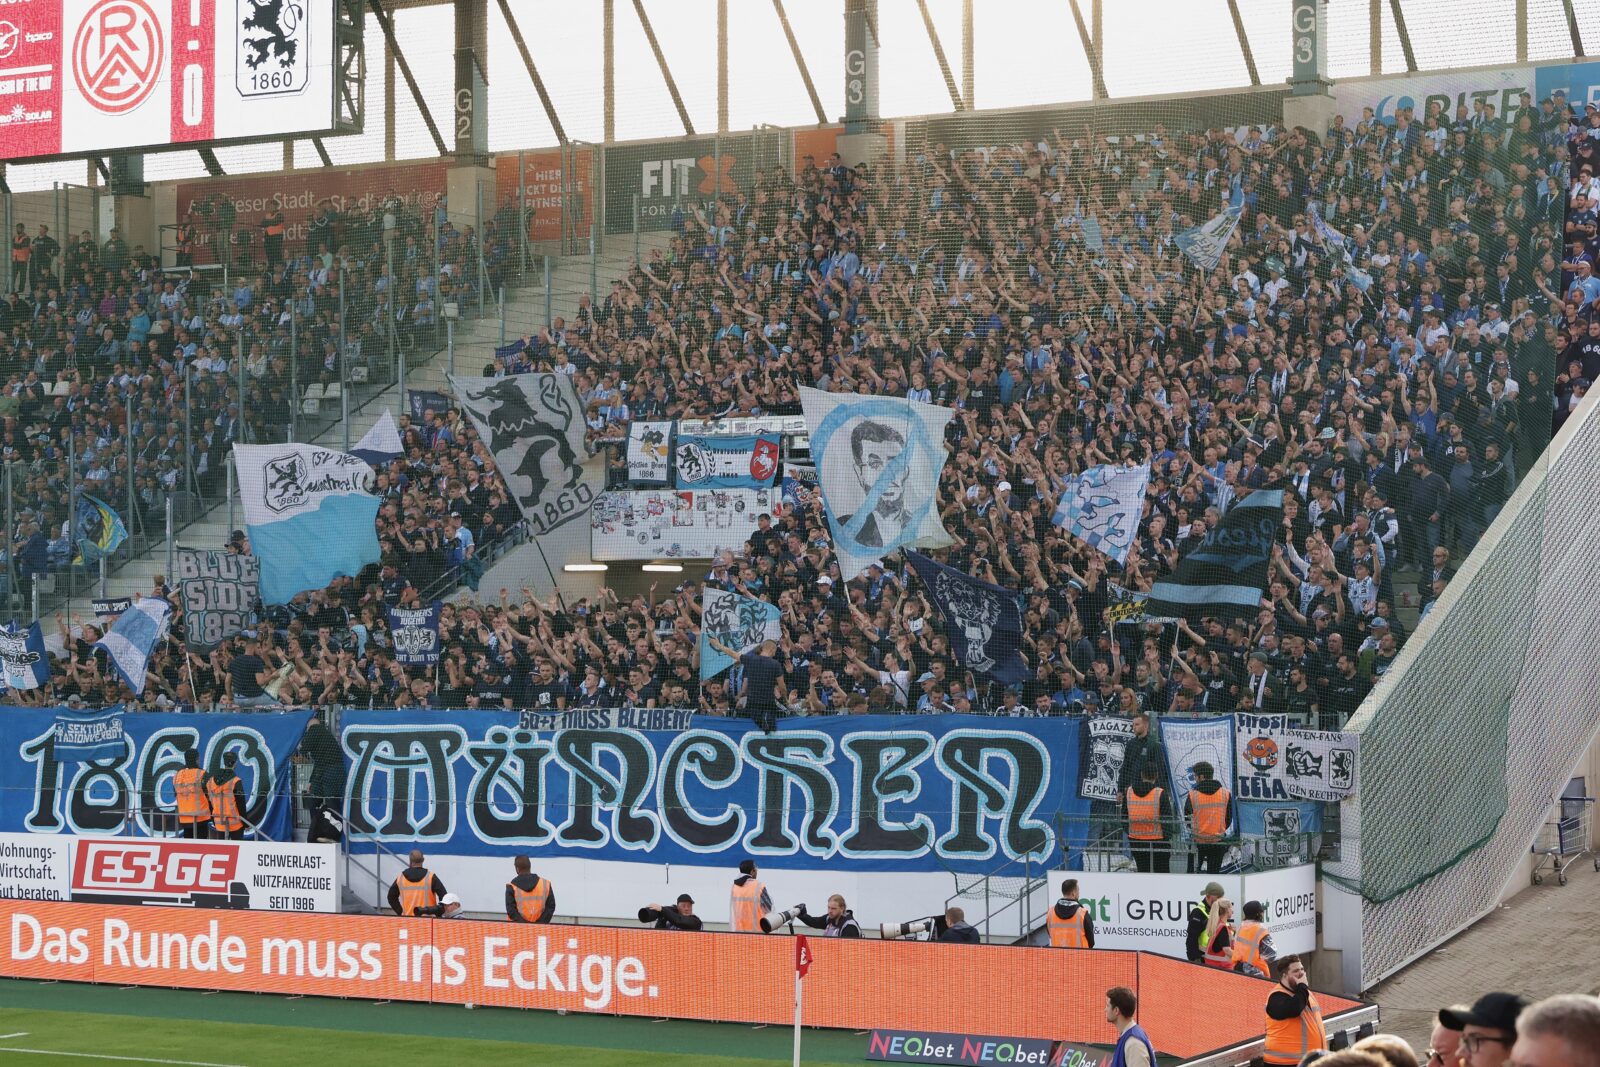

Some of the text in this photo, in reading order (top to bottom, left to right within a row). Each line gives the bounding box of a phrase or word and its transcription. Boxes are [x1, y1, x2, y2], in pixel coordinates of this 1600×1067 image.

[251, 71, 292, 90] 1860
[26, 111, 52, 121] SOLAR
[642, 203, 666, 217] FOR
[533, 482, 594, 532] 1860
[179, 551, 259, 583] BLUE
[185, 580, 257, 612] SIDE
[187, 612, 247, 644] 186
[67, 722, 108, 734] SEKTION
[562, 708, 611, 730] MUSS
[618, 707, 692, 730] BLEIBEN!
[1093, 720, 1134, 734] RAGAZZ
[1237, 714, 1287, 729] TIFOSI
[1286, 731, 1343, 743] ÖWEN-FANS
[20, 725, 277, 839] 1860
[1085, 785, 1118, 796] SPUMA
[1238, 776, 1289, 800] TELA
[340, 722, 1056, 867] MÜNCHEN
[257, 853, 326, 869] SCHWERLAST-
[18, 883, 64, 902] beraten.
[253, 874, 331, 892] NUTZFAHRZEUGE
[269, 895, 315, 911] SEIT 1986
[1274, 892, 1315, 918] GRUPPE
[1103, 926, 1188, 938] WASSERSCHADENS
[11, 913, 660, 1010] Das Runde muss ins Eckige.
